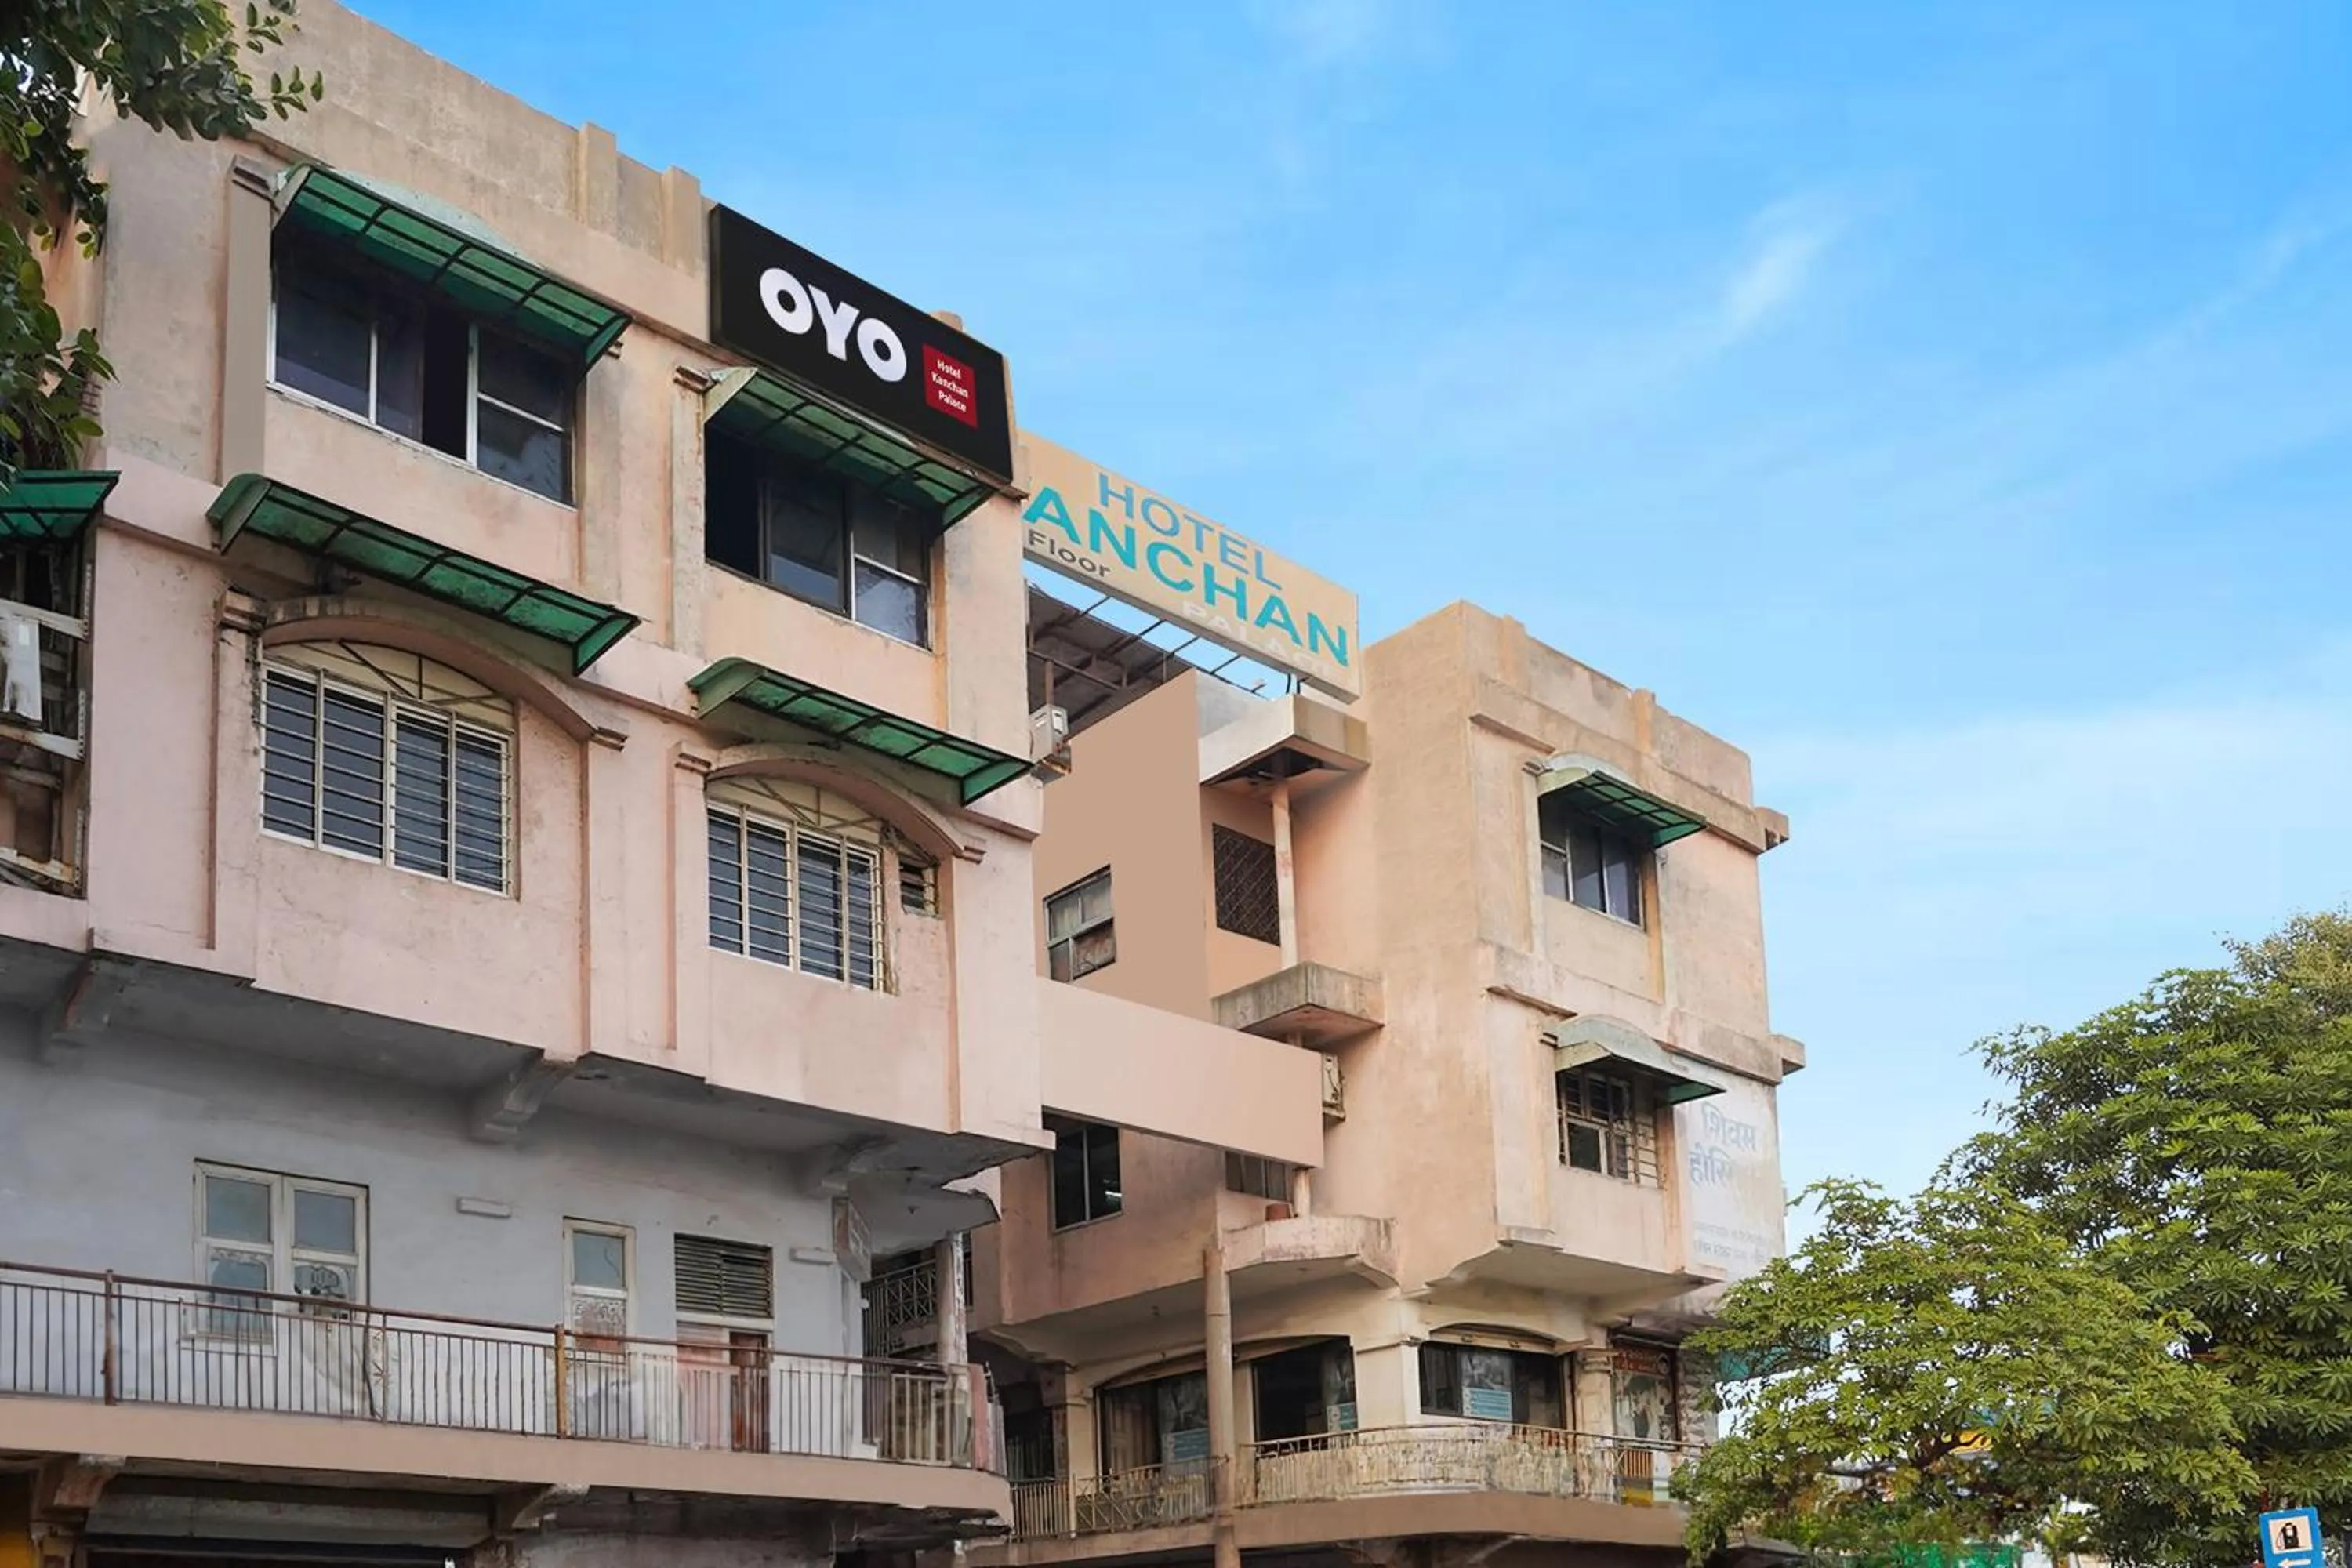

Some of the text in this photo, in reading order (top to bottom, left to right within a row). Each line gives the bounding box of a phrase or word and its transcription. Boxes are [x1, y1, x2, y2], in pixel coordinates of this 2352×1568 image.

[760, 267, 907, 382] OYO
[931, 371, 969, 398] Kanchan
[936, 358, 962, 380] Hotel
[938, 390, 967, 413] Palace
[1028, 528, 1111, 578] Floor
[1098, 473, 1282, 590] HOTEL
[1022, 486, 1348, 666] ANCHAN
